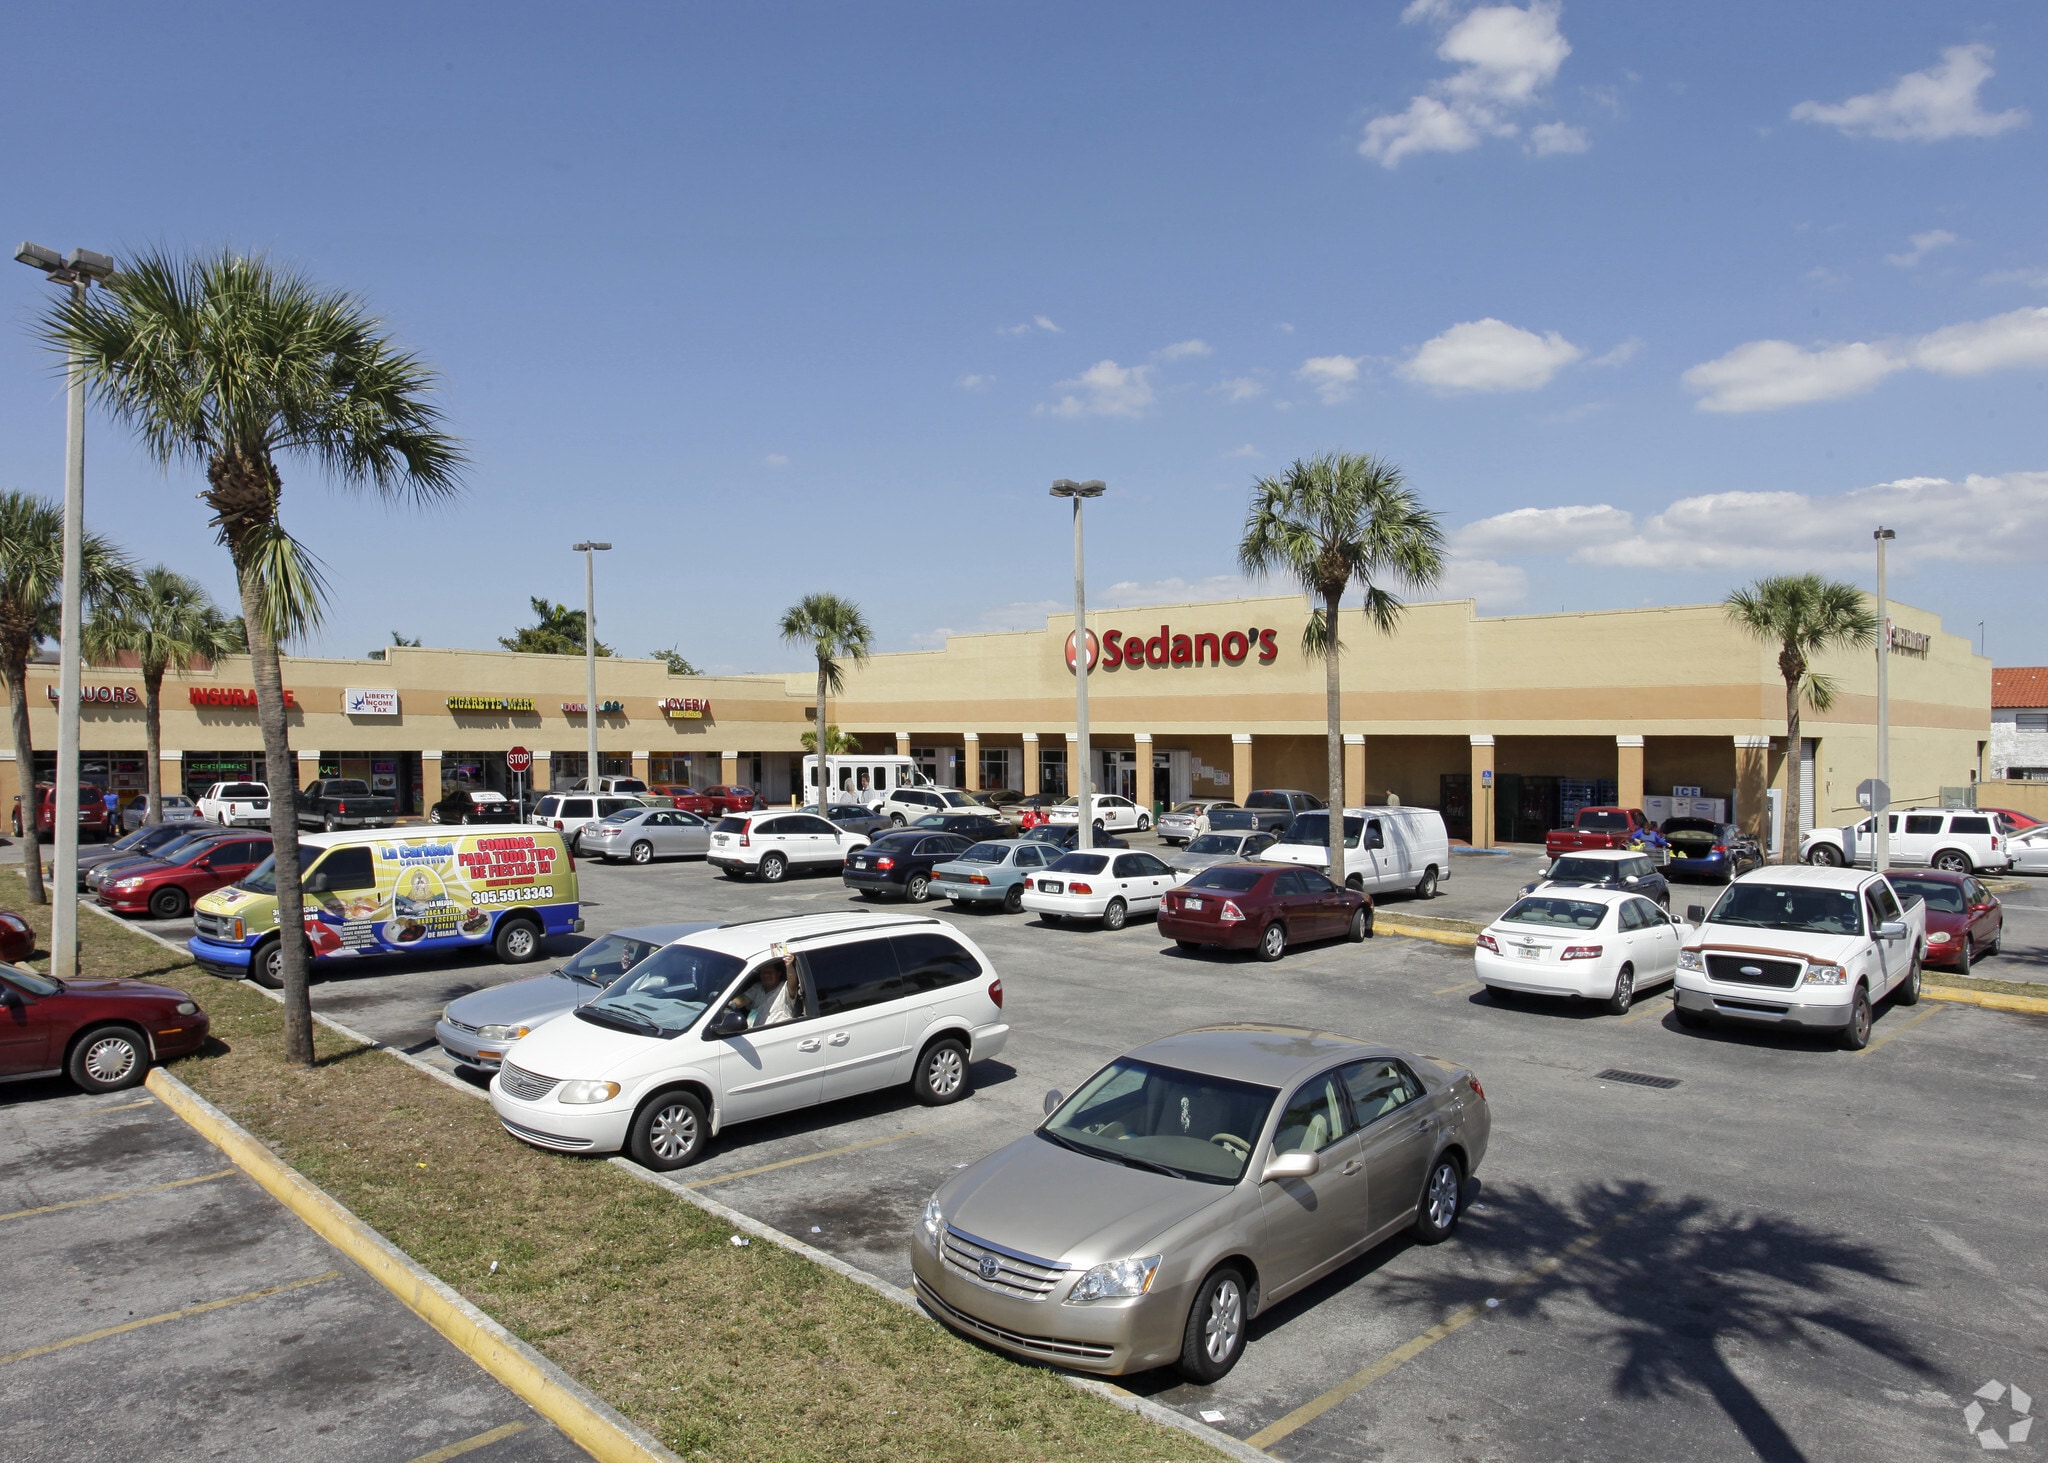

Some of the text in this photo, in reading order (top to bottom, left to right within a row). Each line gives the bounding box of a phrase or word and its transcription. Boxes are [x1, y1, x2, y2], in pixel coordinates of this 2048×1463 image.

[1102, 625, 1279, 667] Sedano's
[47, 684, 138, 703] LUORS
[189, 687, 295, 708] INSURAE
[364, 691, 394, 700] LIBERTY
[366, 699, 393, 707] INCOME
[373, 705, 387, 713] TAX
[448, 695, 536, 711] CIGARETTE MART
[562, 702, 600, 712] DOLLR
[661, 697, 711, 711] JOYERIA
[509, 753, 529, 764] STOP
[191, 763, 248, 771] SEGUROS
[1675, 787, 1698, 797] ICE
[477, 836, 535, 851] COMIDAS
[381, 843, 454, 860] La Caridad
[458, 847, 556, 867] PARA TODO TIPO
[400, 857, 446, 867] CAFETERIA
[470, 865, 487, 879] DE
[488, 862, 537, 878] FIESTAS
[472, 886, 554, 905] 305.591.3343
[436, 930, 458, 938] MIAMI
